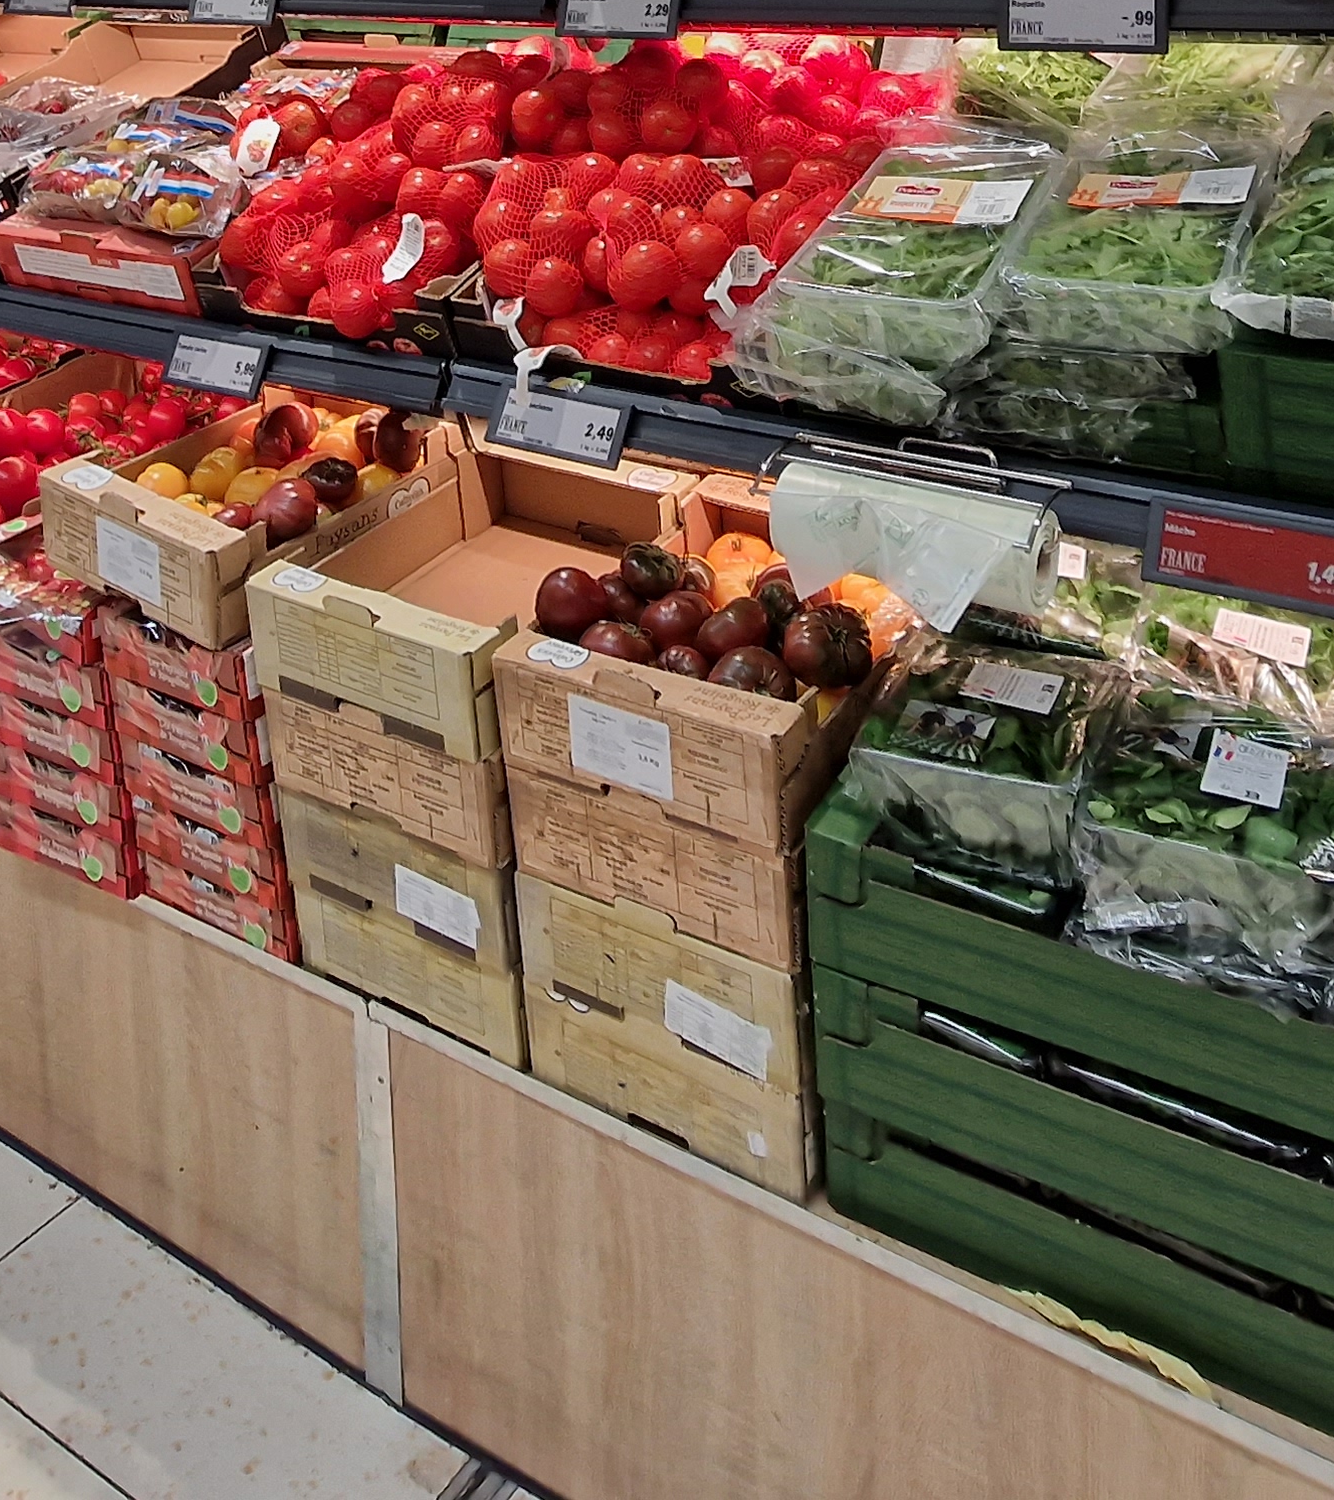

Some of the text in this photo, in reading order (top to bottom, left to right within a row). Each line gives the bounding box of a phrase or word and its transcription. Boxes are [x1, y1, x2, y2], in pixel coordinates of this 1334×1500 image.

[644, 3, 669, 18] 2,29
[1011, 21, 1043, 36] FRANCE
[584, 422, 614, 442] 2,49
[1160, 547, 1207, 574] FRANCE
[684, 694, 743, 721] Paysans
[693, 685, 760, 713] Rougeline
